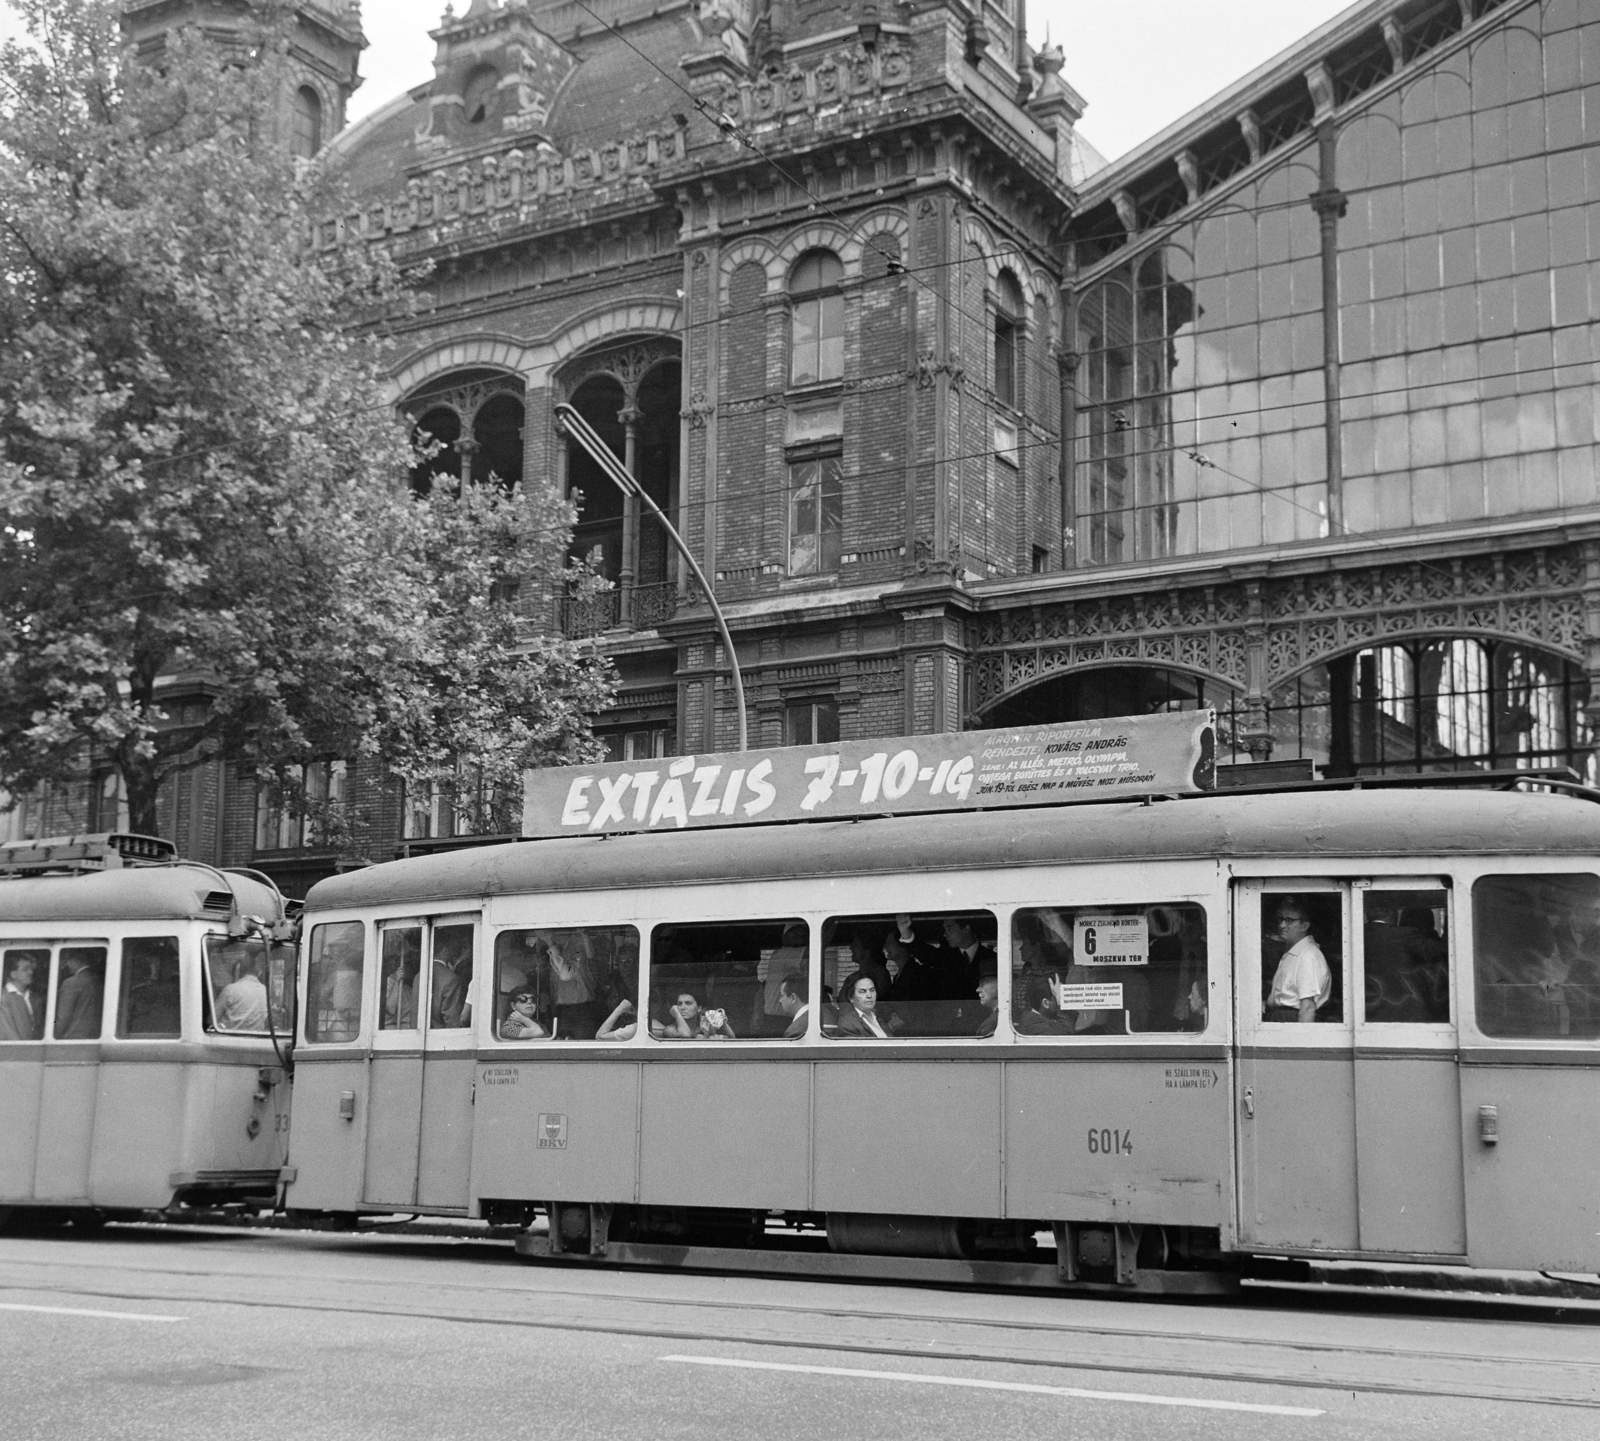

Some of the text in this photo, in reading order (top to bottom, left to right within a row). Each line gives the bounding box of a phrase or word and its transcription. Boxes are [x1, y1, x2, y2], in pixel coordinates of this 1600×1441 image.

[980, 734, 1128, 760] RENDEZTE: KOVÁCS ANDRÁS
[984, 727, 1102, 746] MAGYAR RIPORTFILM
[978, 771, 1013, 784] OMEGA
[1053, 765, 1066, 777] ÉS
[1065, 768, 1073, 776] A
[1117, 762, 1140, 773] TRIO.
[561, 750, 974, 831] EXTÁZIS 7-10-IG
[1017, 780, 1040, 792] EGÉSZ
[1040, 781, 1057, 790] NAP
[1057, 781, 1065, 789] A
[1097, 777, 1117, 786] MOZI
[1085, 928, 1096, 955] 6
[1129, 954, 1142, 962] TÉR
[539, 1139, 566, 1147] BKV
[1088, 1128, 1133, 1154] 6014
